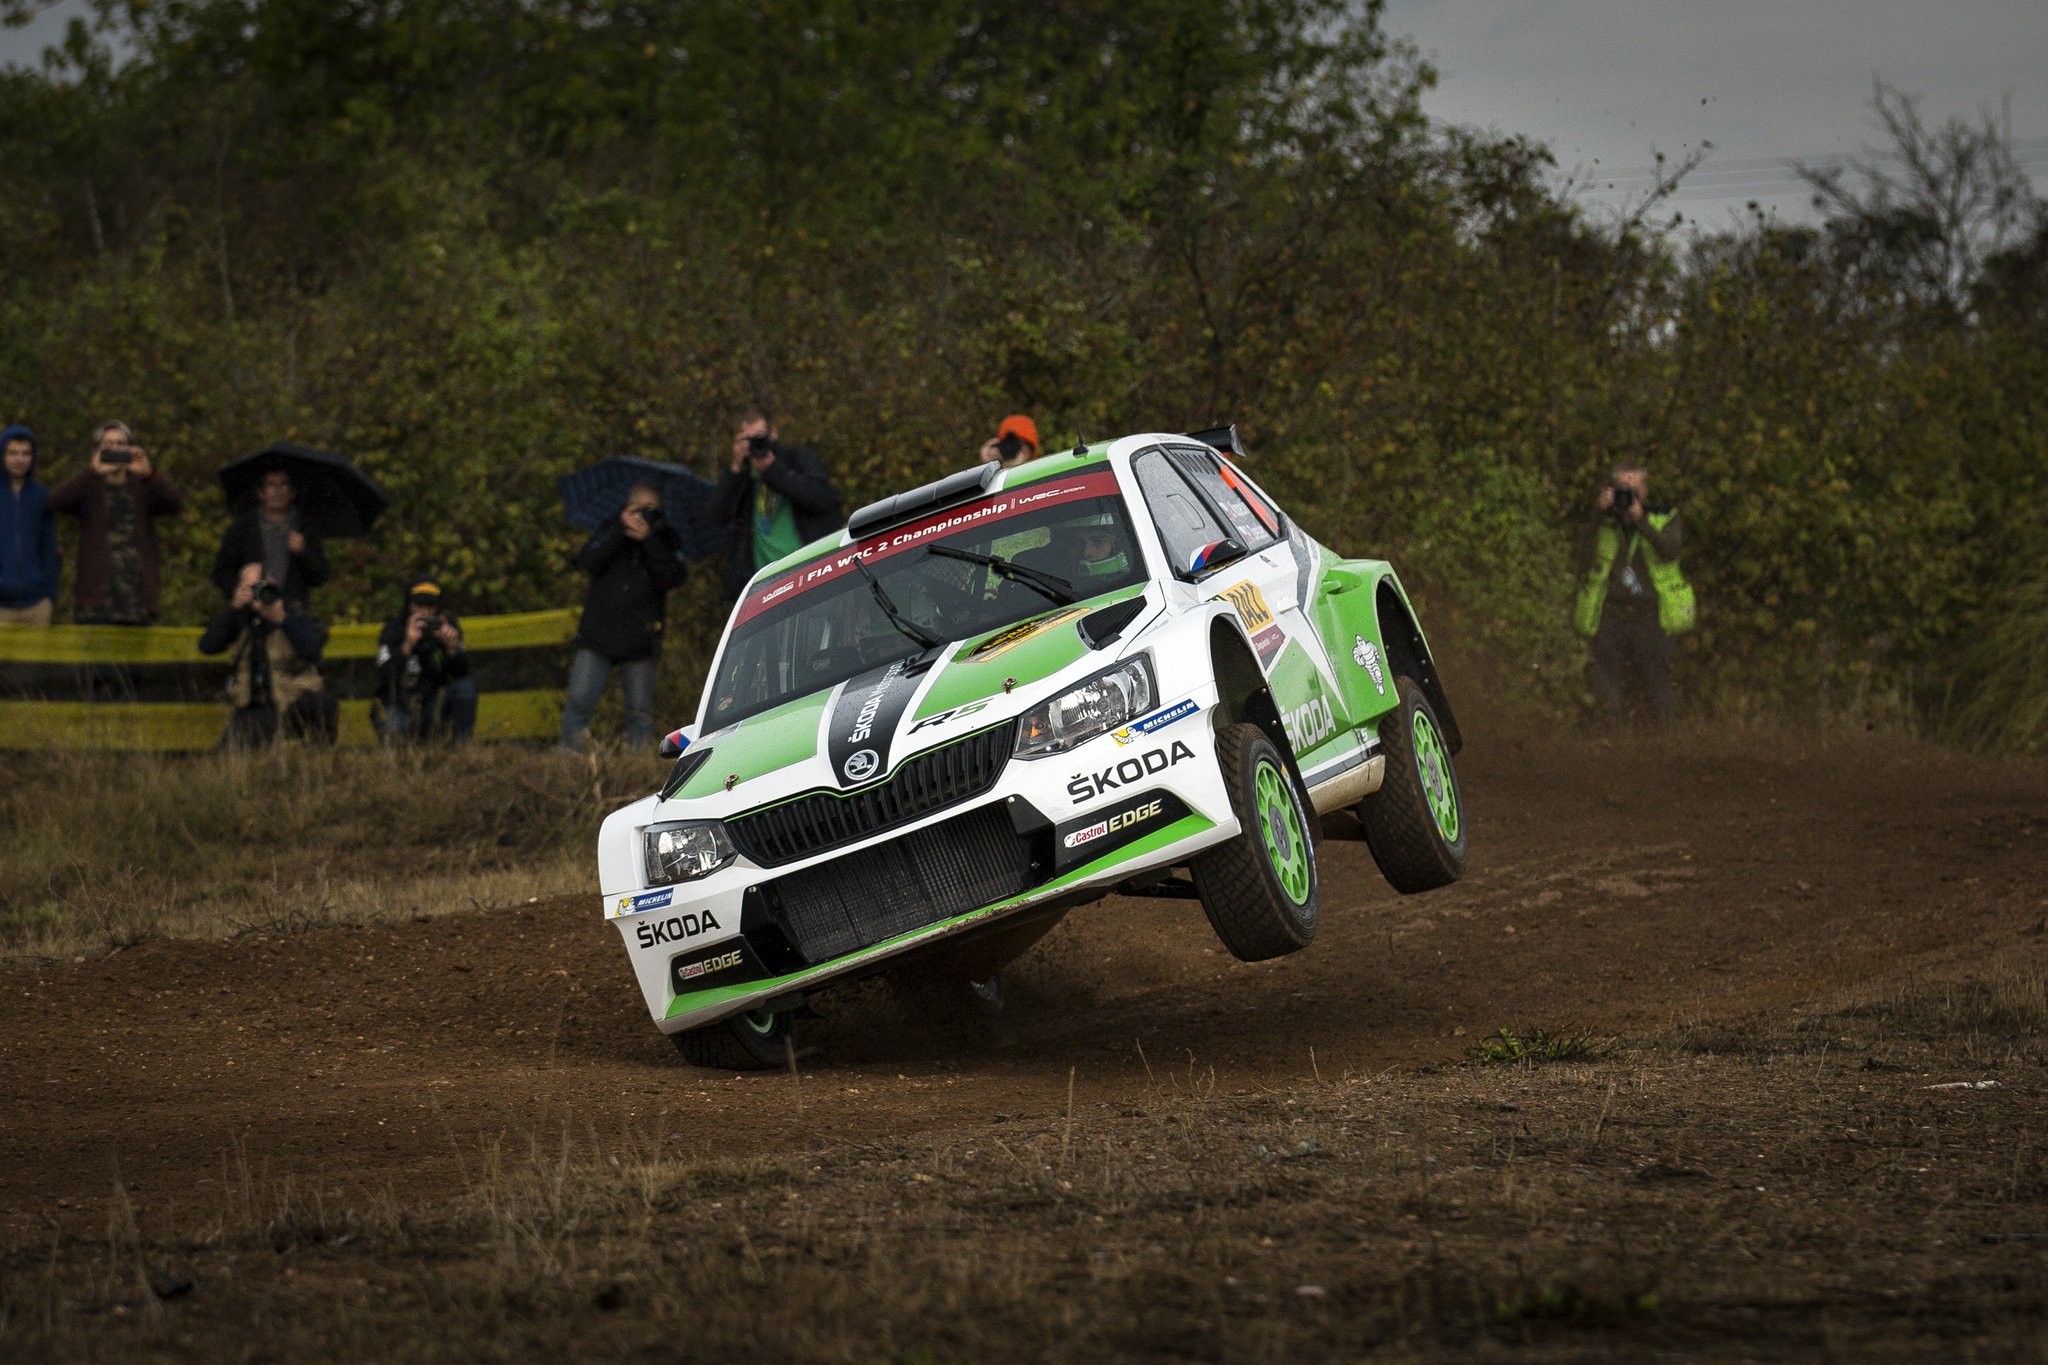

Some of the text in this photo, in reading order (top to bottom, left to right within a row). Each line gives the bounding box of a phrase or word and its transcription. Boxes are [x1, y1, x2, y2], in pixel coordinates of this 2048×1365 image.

[1019, 486, 1086, 505] WRC.com
[807, 503, 1008, 582] FIA WRC 2 Championship
[847, 693, 884, 743] ŠKODA
[1142, 701, 1195, 731] MICHELIN
[1066, 740, 1196, 805] ŠKODA
[1075, 799, 1163, 844] Castrol EDGE
[637, 891, 674, 906] MICHELIN
[636, 909, 722, 950] ŠKODA
[703, 949, 743, 973] EDGE
